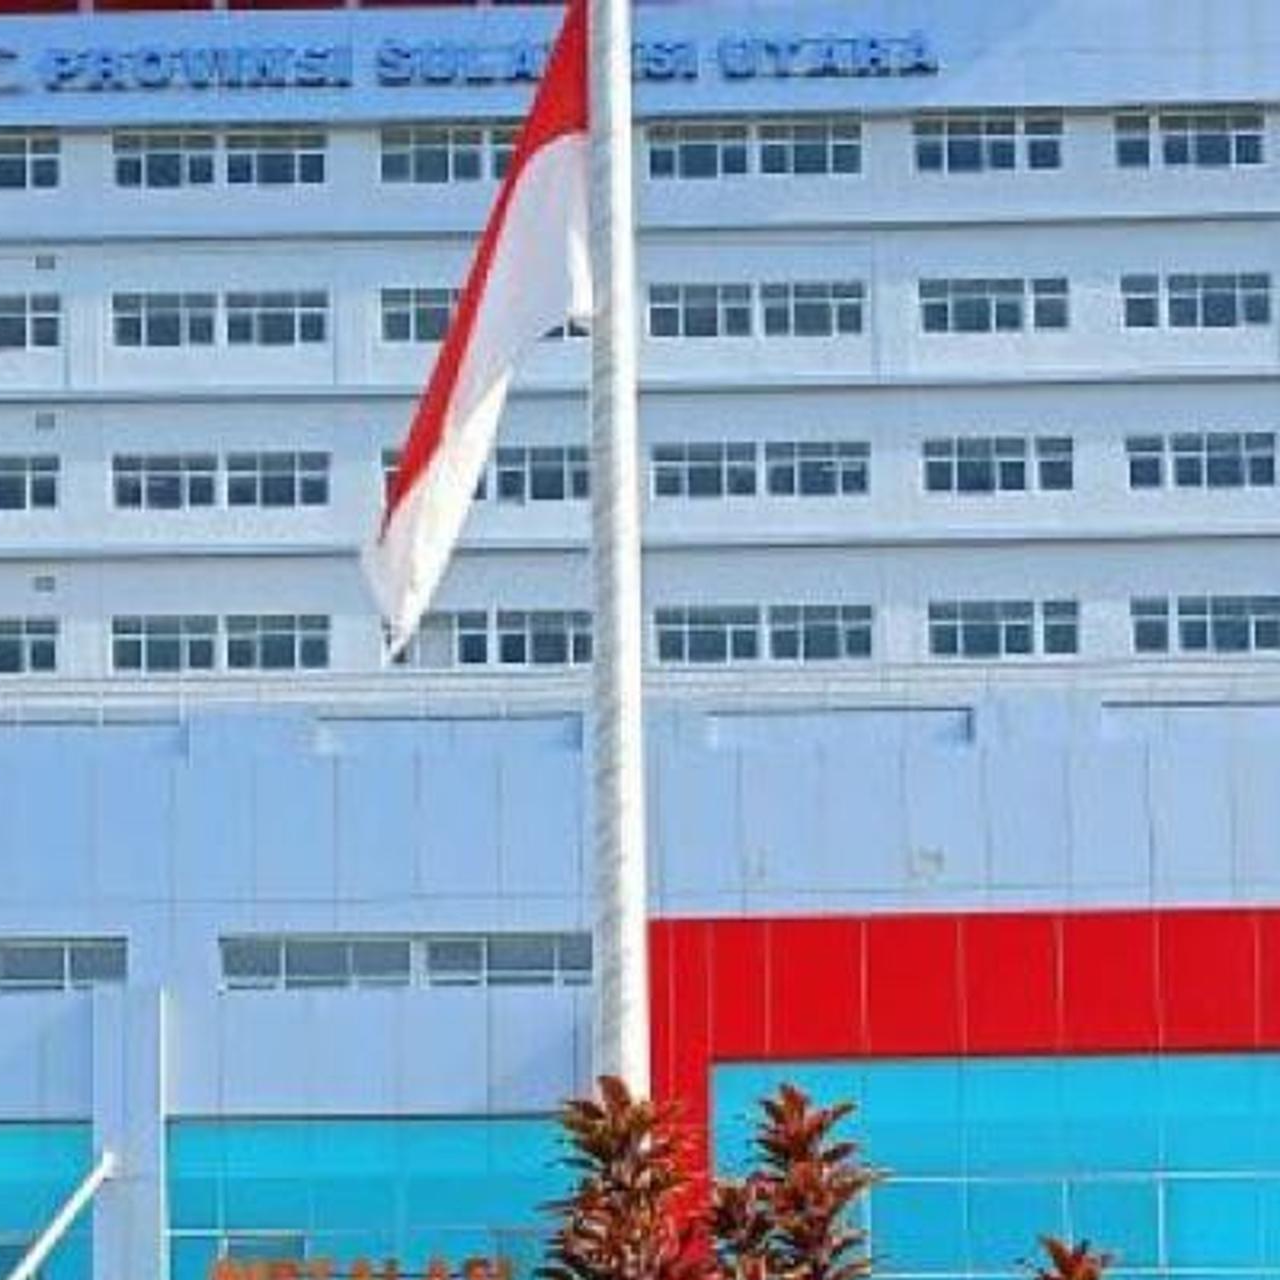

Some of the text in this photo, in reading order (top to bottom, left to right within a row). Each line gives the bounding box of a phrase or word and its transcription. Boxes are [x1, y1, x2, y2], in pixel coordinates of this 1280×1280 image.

[43, 46, 355, 93] PROVINSI
[376, 36, 700, 87] SULASI
[717, 30, 939, 82] UTARA
